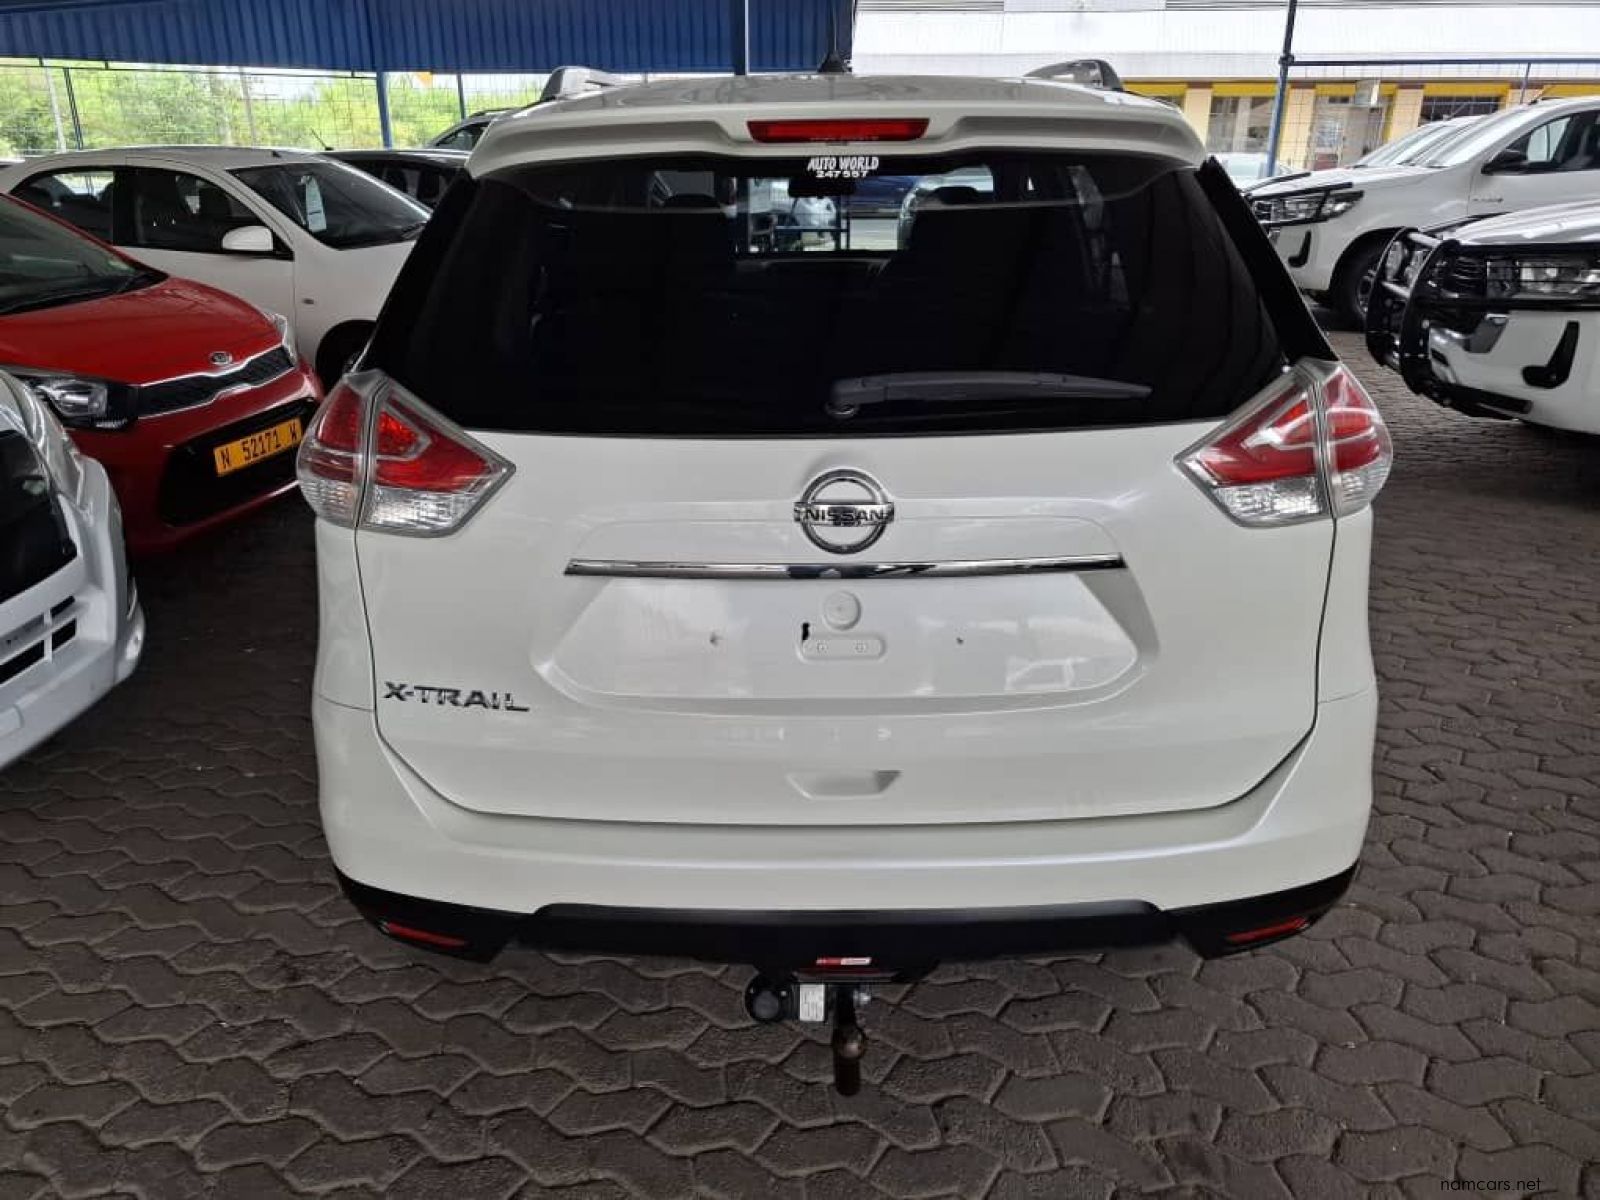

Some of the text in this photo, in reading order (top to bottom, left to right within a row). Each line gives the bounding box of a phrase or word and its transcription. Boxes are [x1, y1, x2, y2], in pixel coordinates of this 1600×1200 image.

[807, 156, 879, 171] AUTO WORLD
[220, 447, 230, 469] N
[804, 508, 884, 521] NISSAN
[384, 681, 530, 712] X-TRAIL
